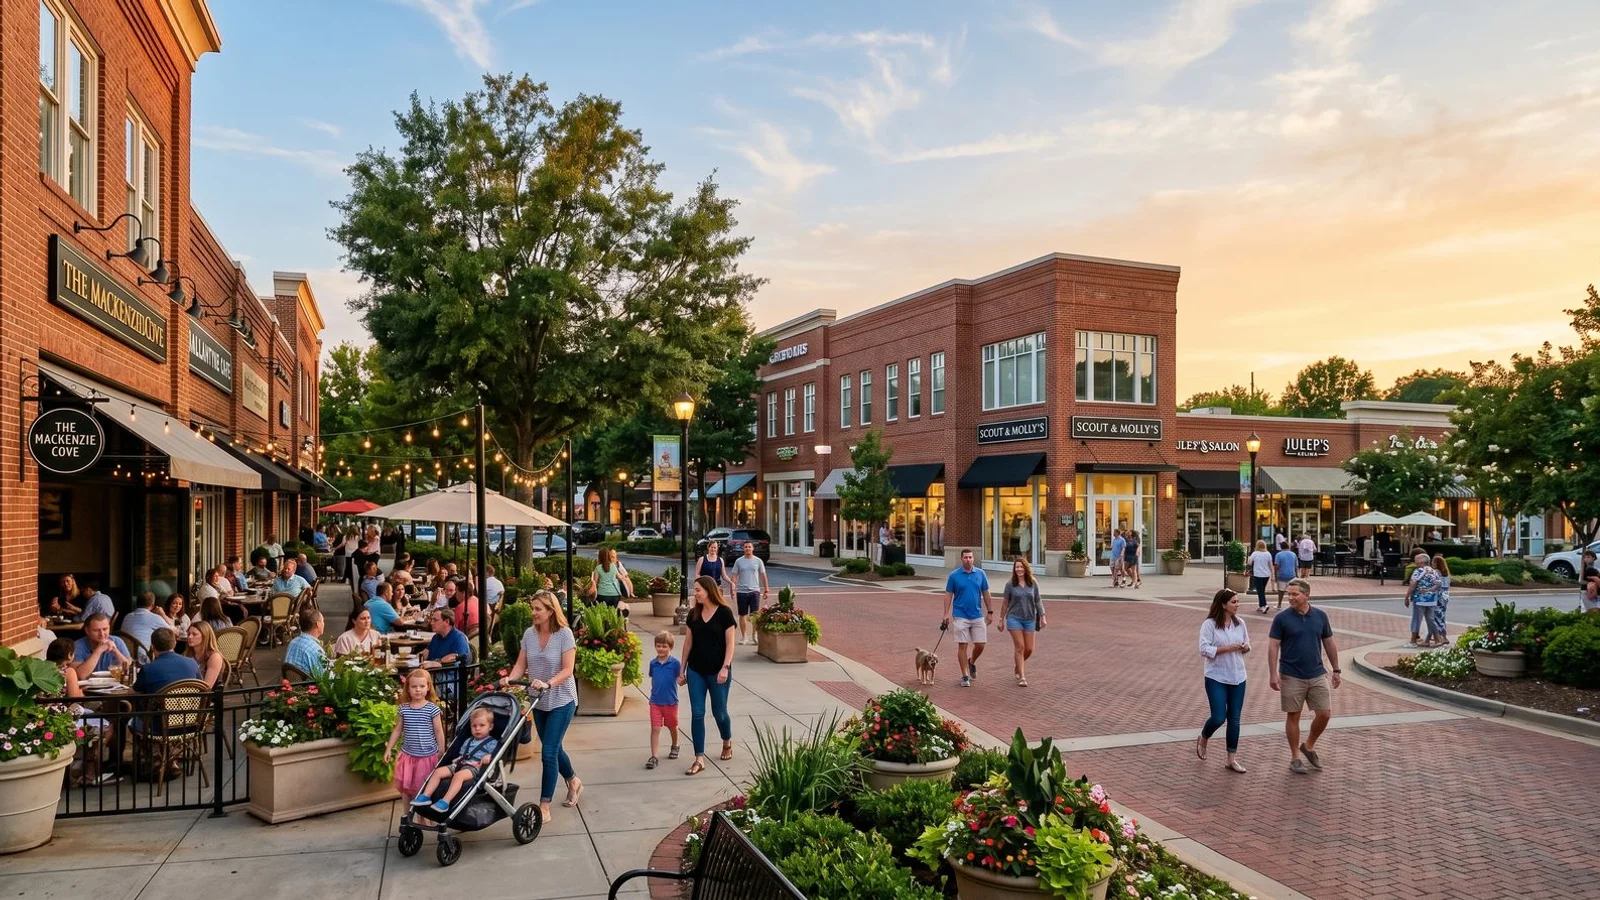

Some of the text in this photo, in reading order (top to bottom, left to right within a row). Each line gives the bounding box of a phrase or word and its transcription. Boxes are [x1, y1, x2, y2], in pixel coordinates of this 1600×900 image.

[63, 259, 88, 300] THE
[55, 421, 77, 433] THE
[979, 422, 1045, 439] SCOUT & MOLLY'S
[1076, 421, 1159, 435] SCOUT & MOLLY'S
[35, 434, 97, 446] MACKENZIE
[1209, 441, 1240, 451] SALON
[1286, 438, 1330, 452] JULEP'S
[51, 446, 80, 457] COVE
